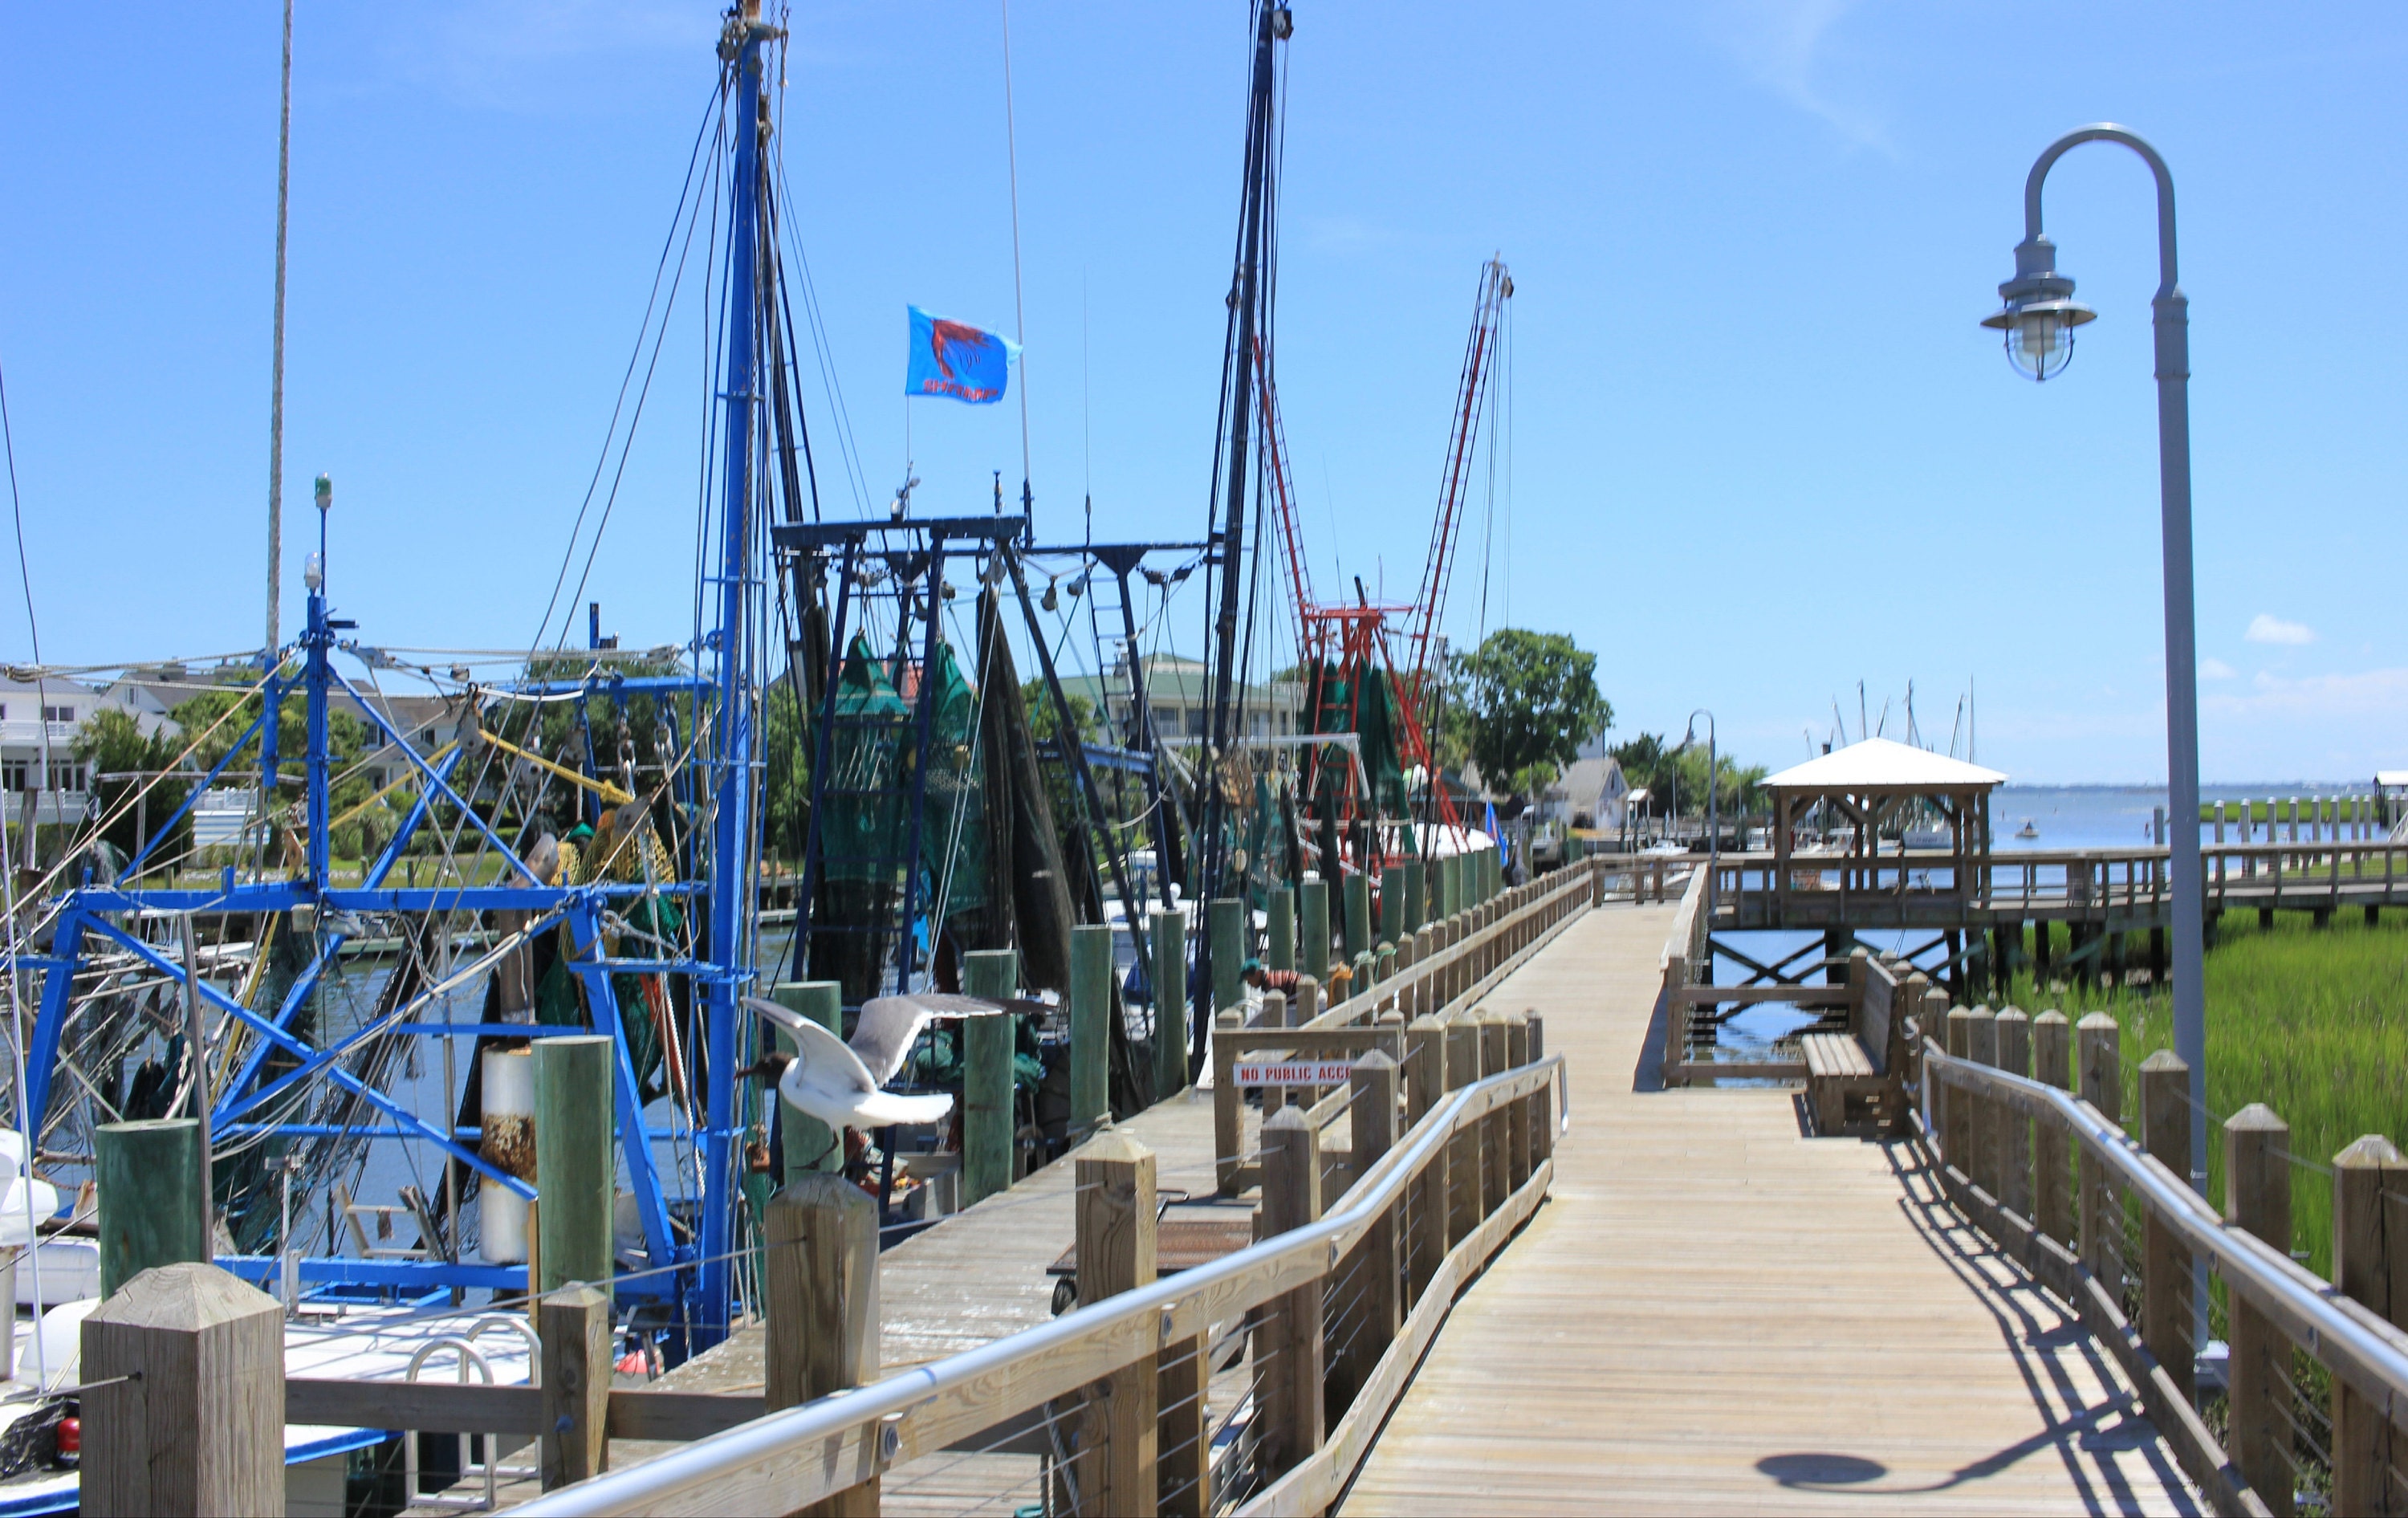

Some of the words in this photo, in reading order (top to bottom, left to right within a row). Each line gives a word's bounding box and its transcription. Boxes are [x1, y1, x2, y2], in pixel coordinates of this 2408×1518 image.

[1241, 1067, 1259, 1081] NO
[1266, 1066, 1312, 1081] PUBLIC
[1318, 1065, 1351, 1081] ACCE
